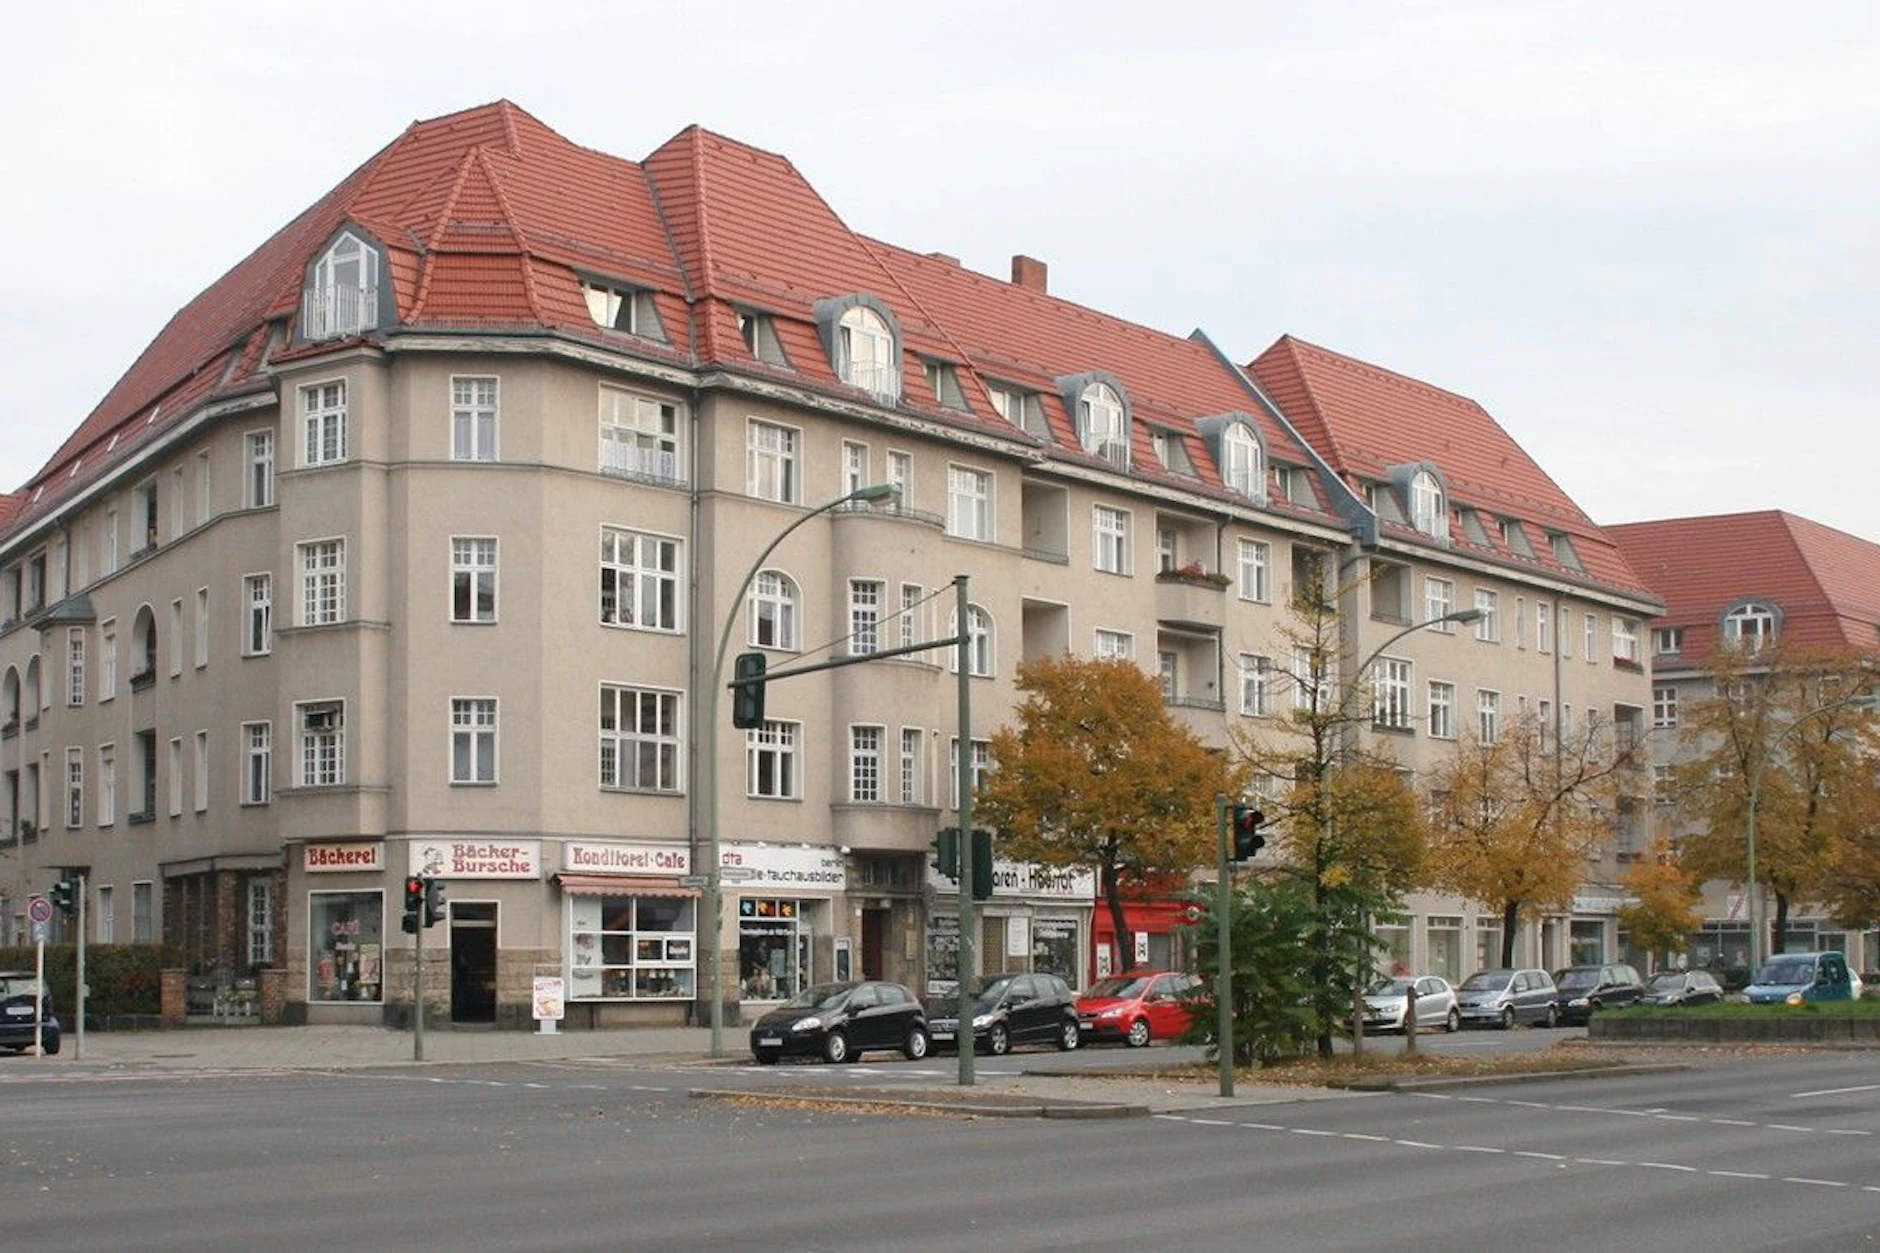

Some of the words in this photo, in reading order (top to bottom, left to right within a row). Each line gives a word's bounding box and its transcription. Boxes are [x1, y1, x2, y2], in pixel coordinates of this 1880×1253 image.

[308, 847, 376, 865] Bäckerei
[452, 859, 531, 873] Bursche
[993, 871, 1019, 887] aren
